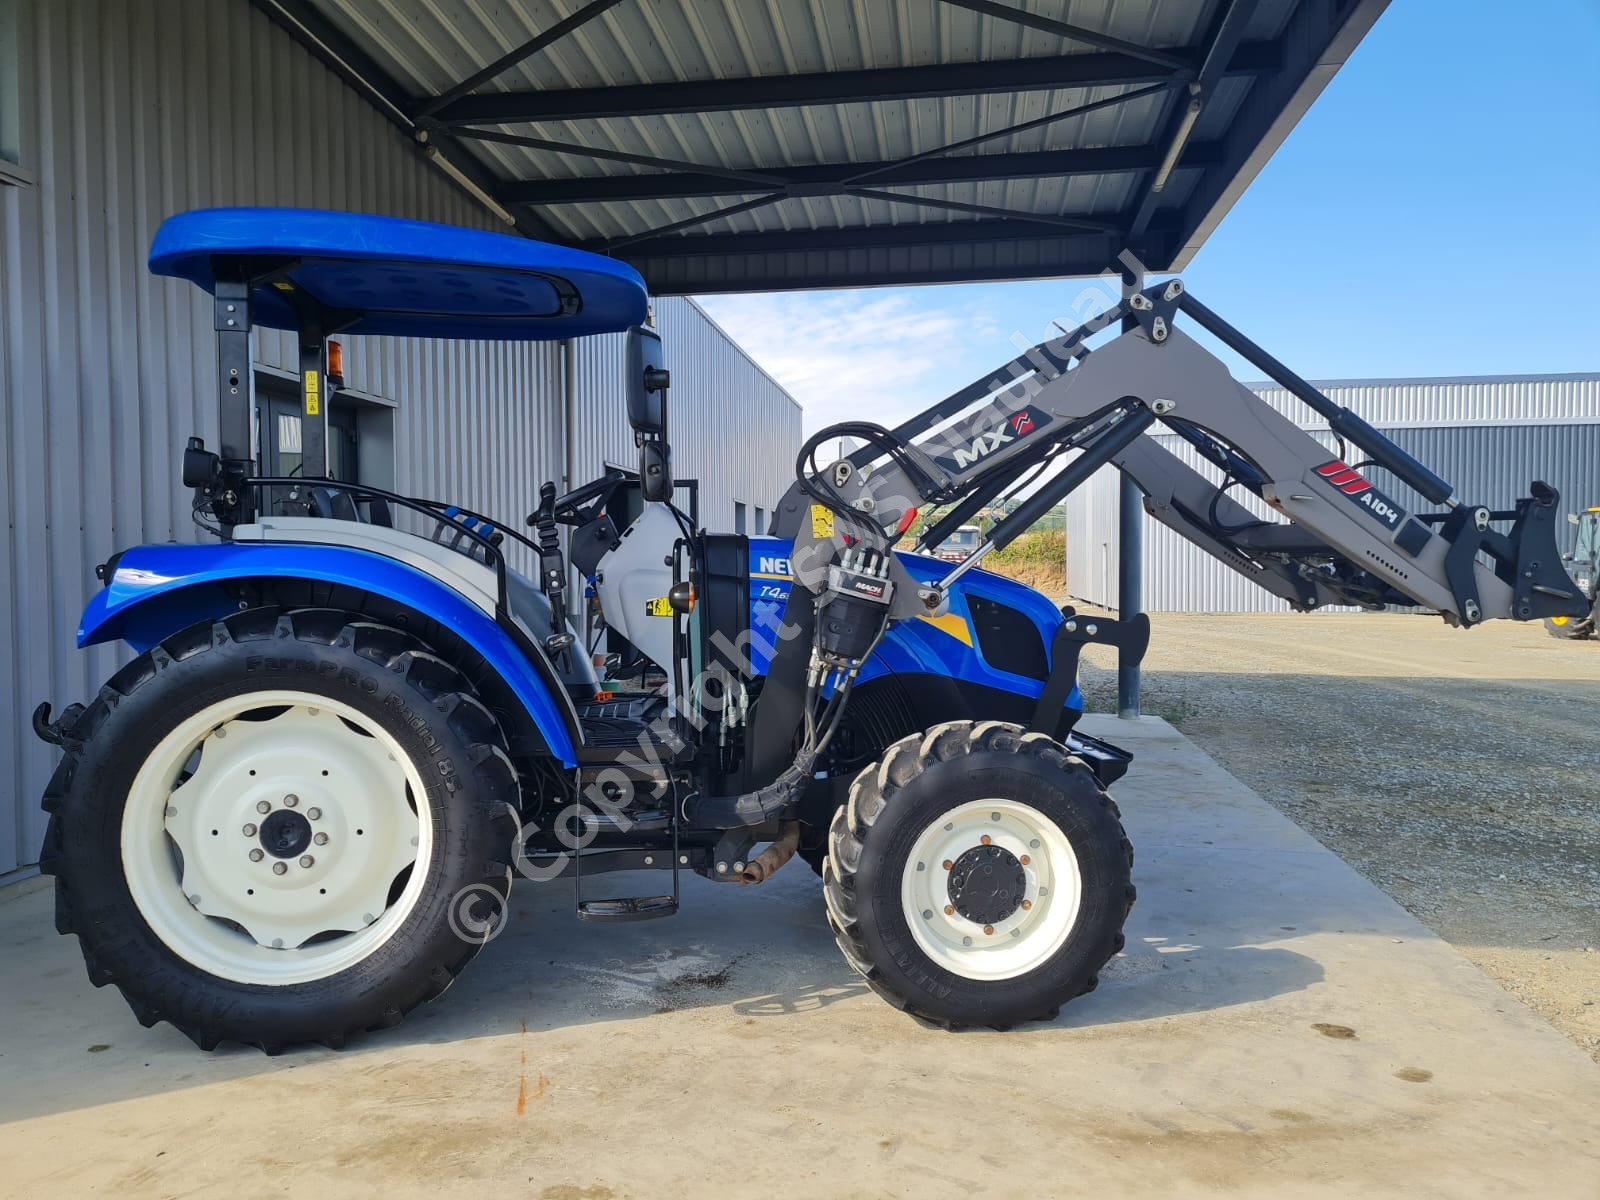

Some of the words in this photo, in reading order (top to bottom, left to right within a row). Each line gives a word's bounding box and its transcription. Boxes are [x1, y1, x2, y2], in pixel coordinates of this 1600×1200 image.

[953, 422, 1015, 469] MX
[760, 556, 794, 576] NE
[855, 582, 882, 594] MACH
